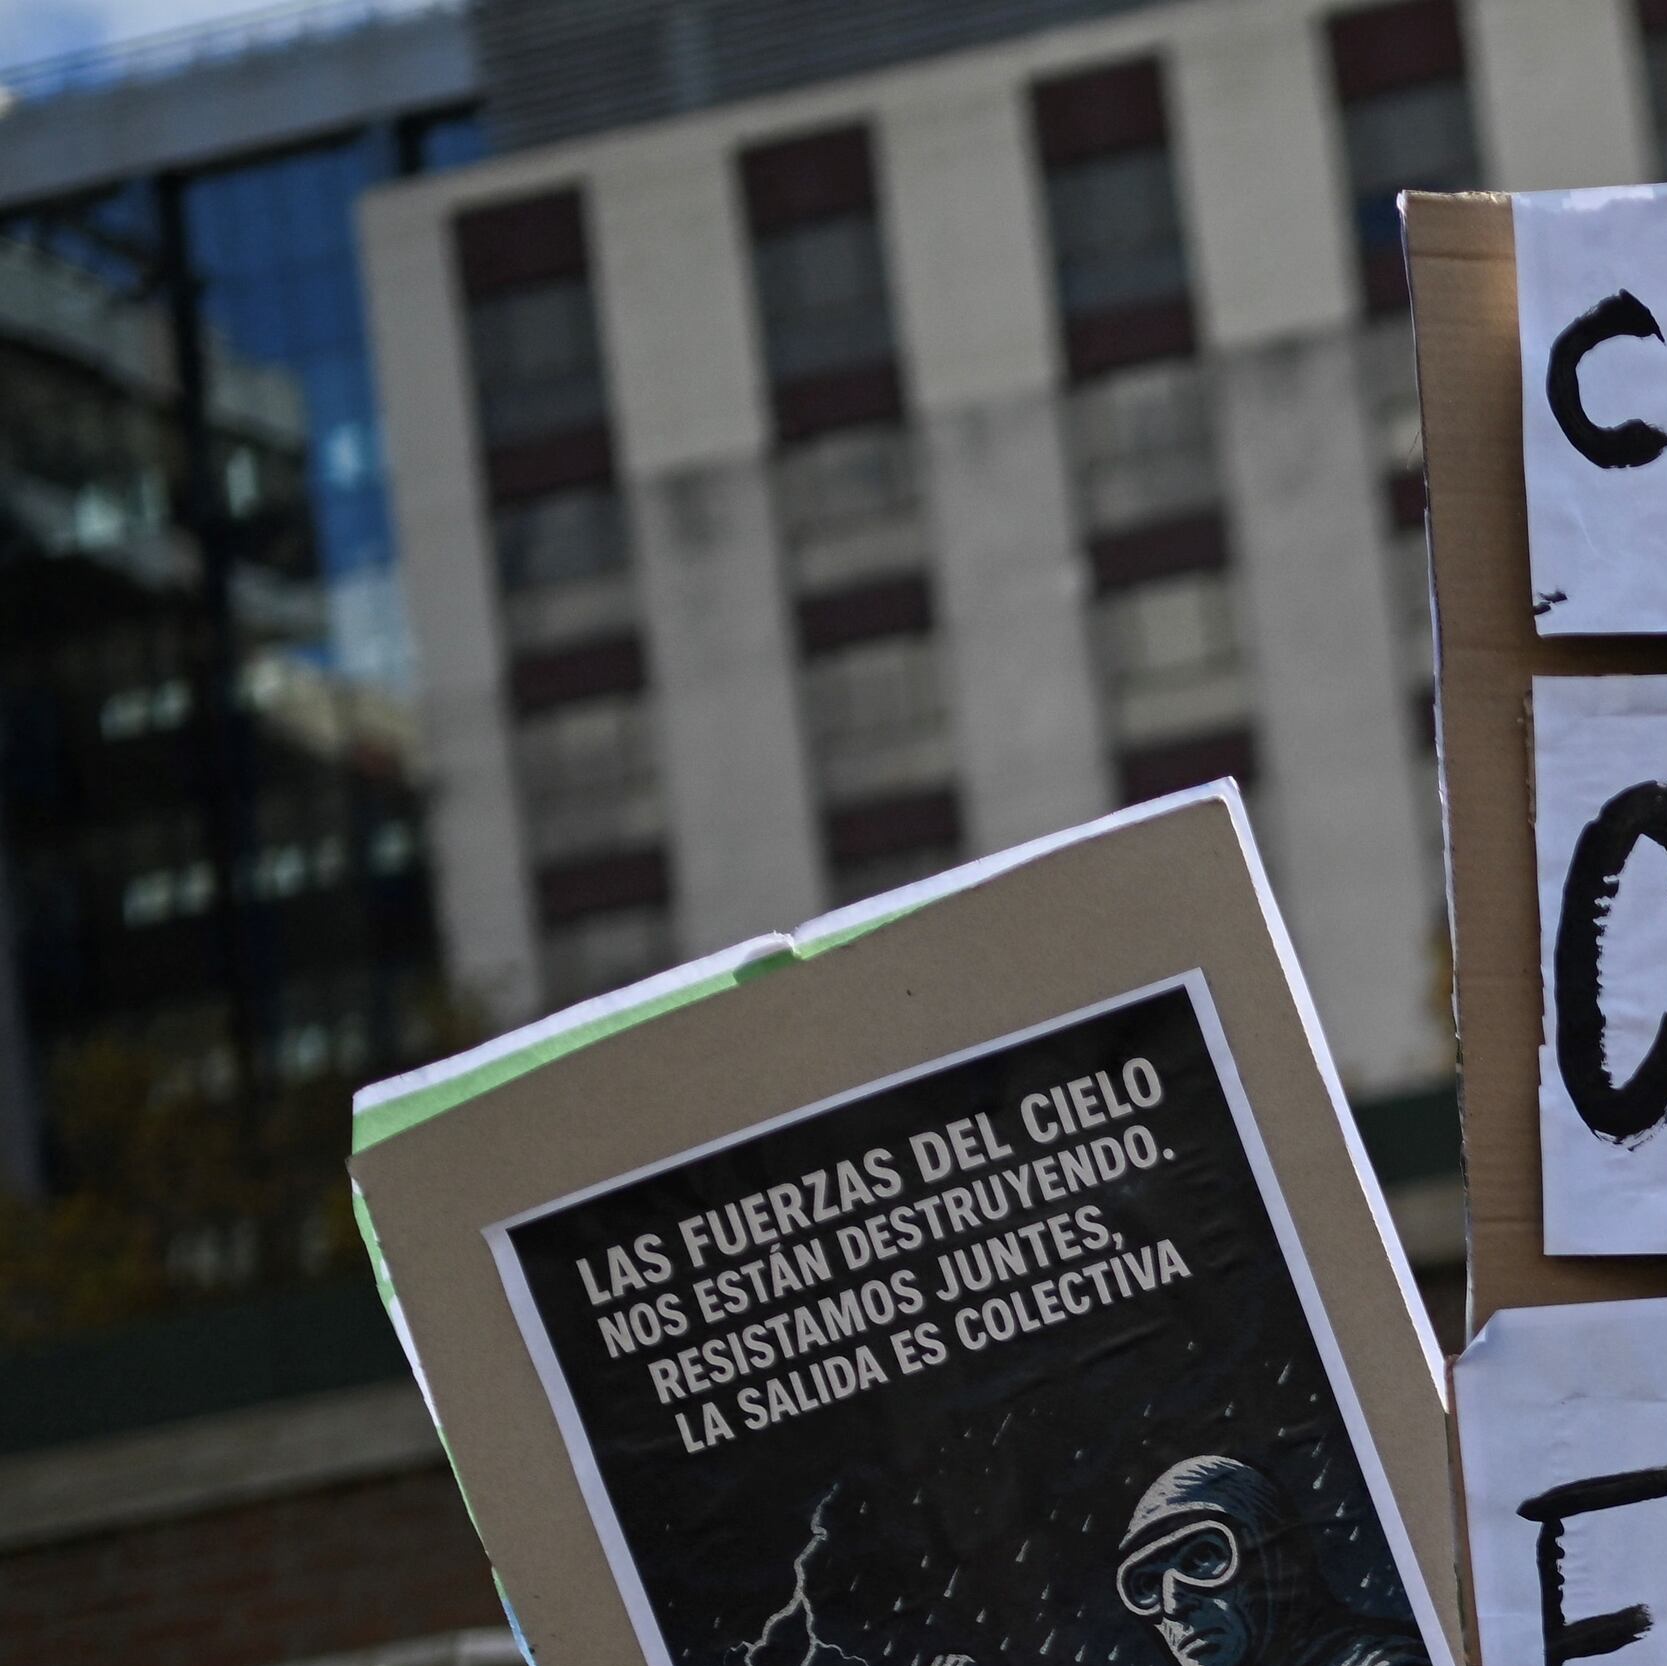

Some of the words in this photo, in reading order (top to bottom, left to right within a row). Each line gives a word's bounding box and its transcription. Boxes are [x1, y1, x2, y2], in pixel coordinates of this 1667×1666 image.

[576, 1234, 671, 1304] LAS
[679, 1149, 901, 1267] FUERZAS
[909, 1113, 1013, 1182] DEL
[1021, 1058, 1161, 1143] CIELO
[598, 1294, 687, 1357] NOS
[693, 1239, 831, 1322] ESTÁN
[836, 1126, 1174, 1269] DESTRUYENDO.
[648, 1270, 923, 1403] RESISTAMOS
[936, 1206, 1123, 1300] JUNTES,
[675, 1402, 734, 1452] LA
[738, 1345, 888, 1429] SALIDA
[890, 1323, 946, 1374] ES
[955, 1239, 1191, 1350] COLECTIVA
